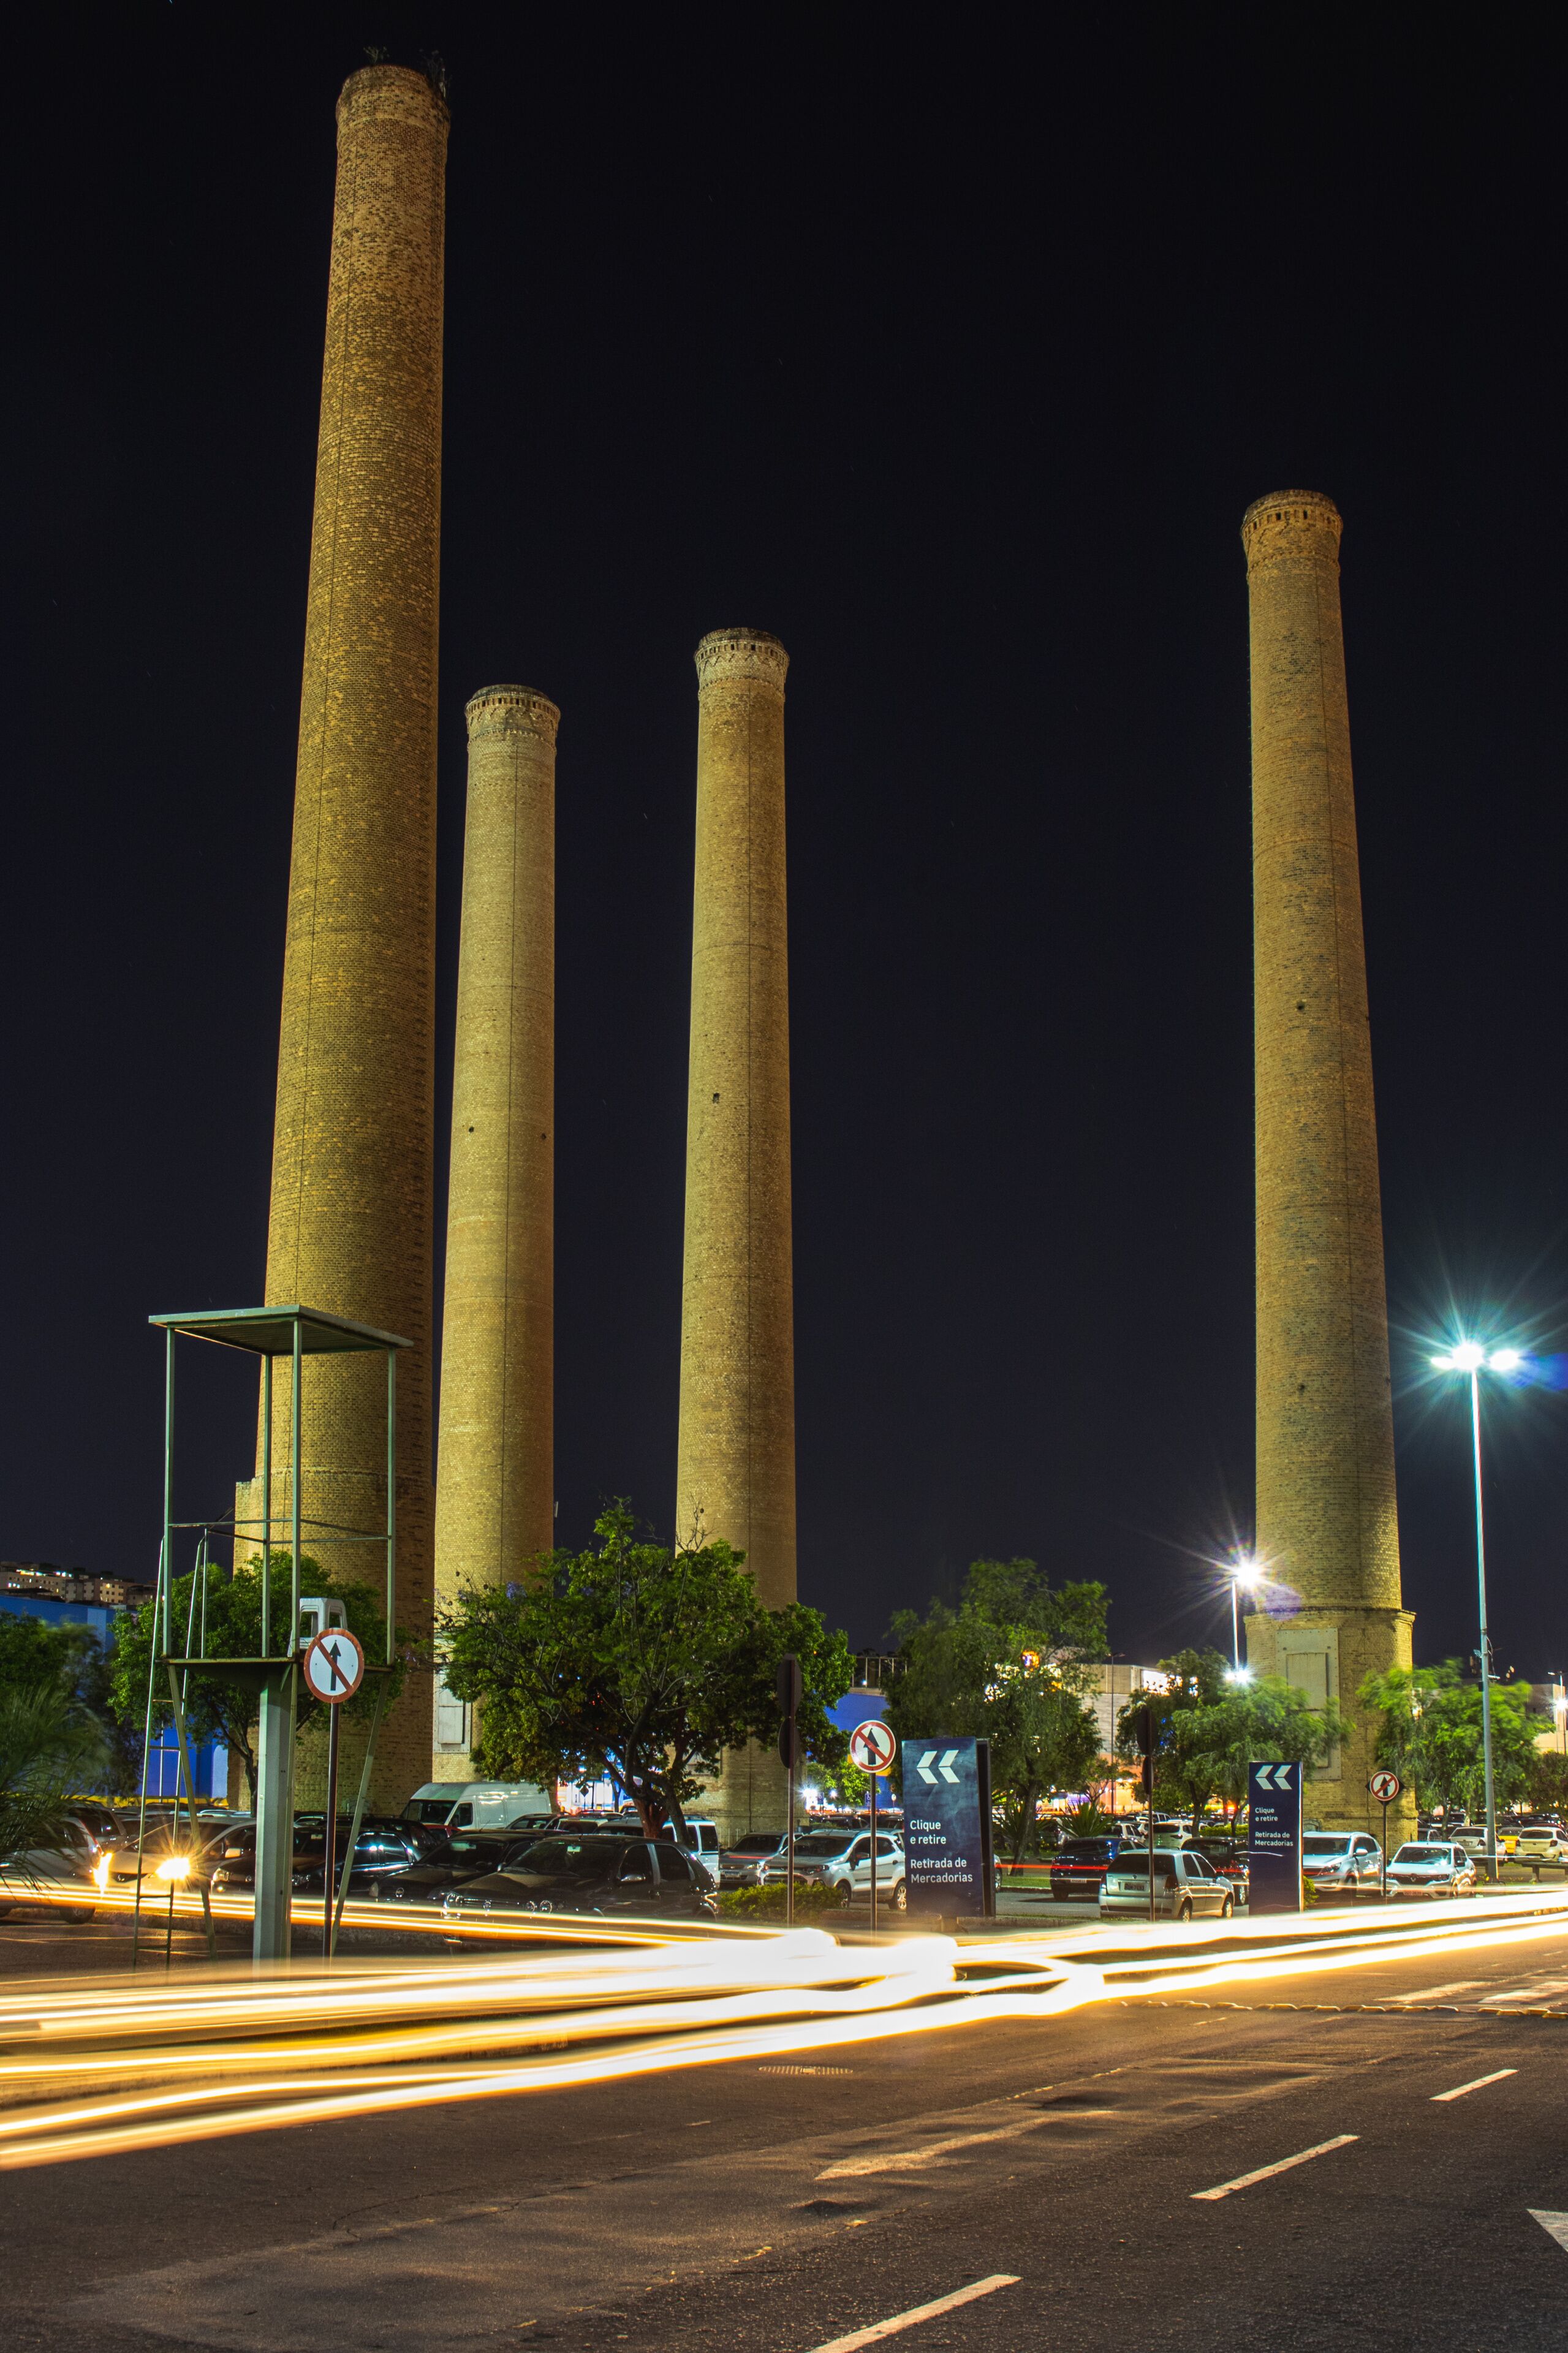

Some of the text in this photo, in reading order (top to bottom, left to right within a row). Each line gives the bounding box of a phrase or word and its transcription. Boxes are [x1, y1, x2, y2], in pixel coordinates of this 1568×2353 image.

[910, 1819, 941, 1832] Clique
[910, 1834, 947, 1844] e retire
[911, 1857, 967, 1869] Retirada de
[911, 1872, 973, 1883] Mercadorias
